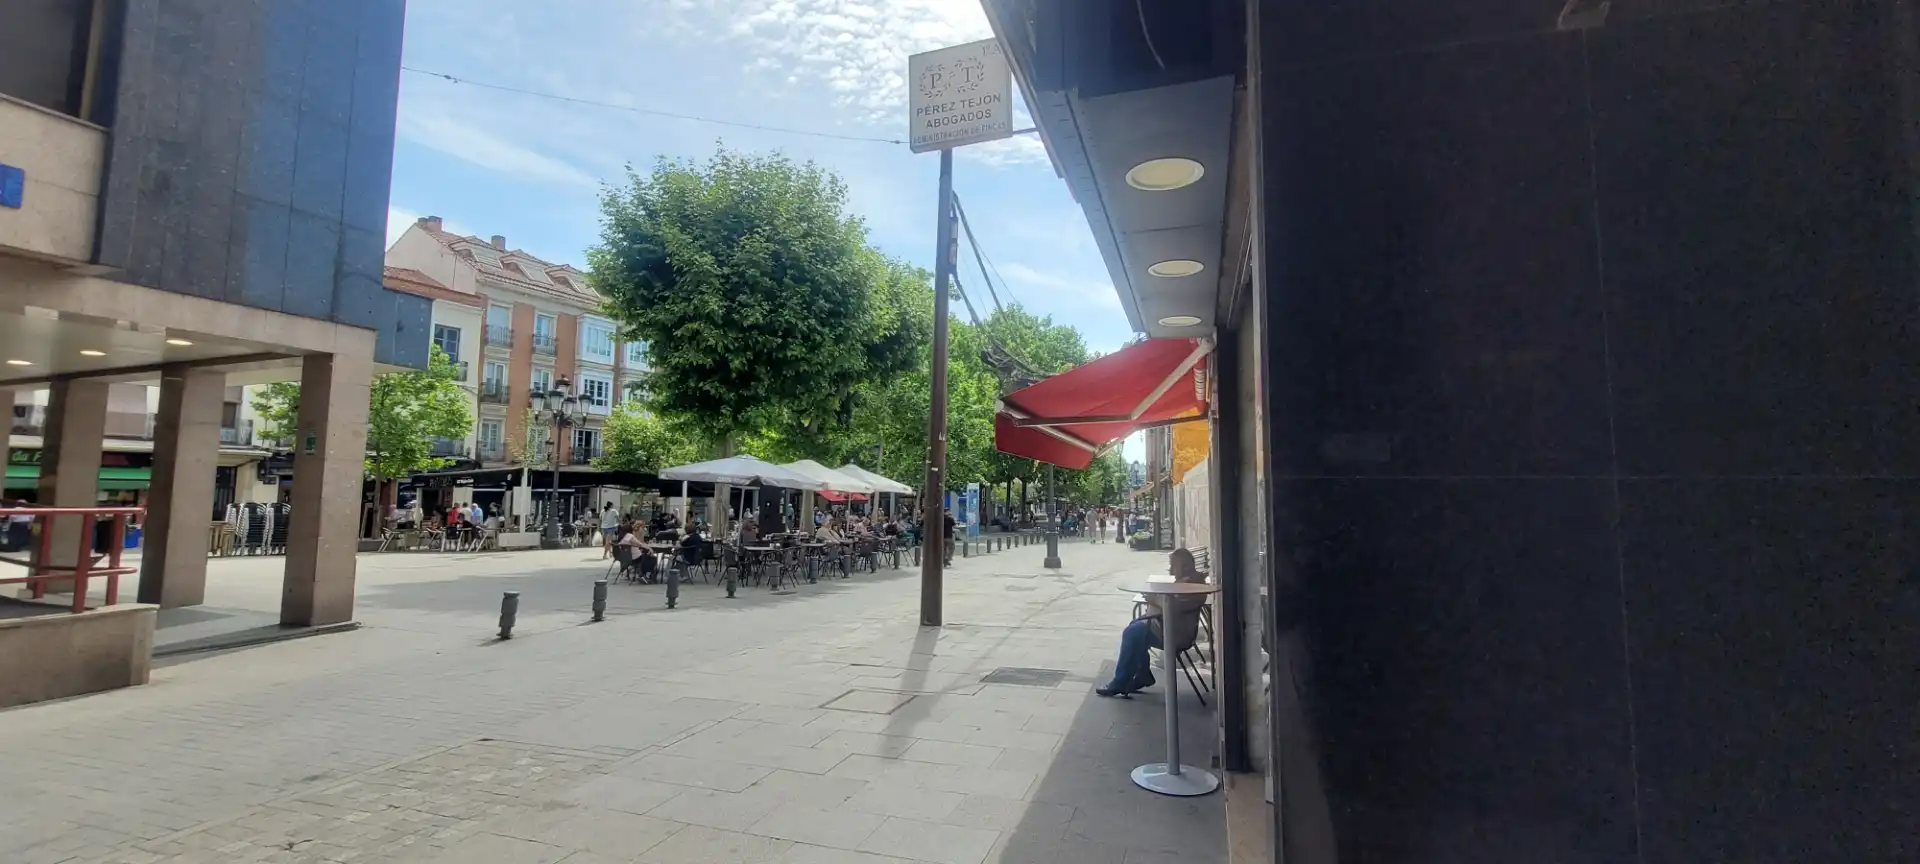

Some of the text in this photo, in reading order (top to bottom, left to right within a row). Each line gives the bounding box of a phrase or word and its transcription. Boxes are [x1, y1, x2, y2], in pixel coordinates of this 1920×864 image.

[930, 66, 974, 90] P T
[916, 92, 1001, 117] PÉREZ TEJÓN
[925, 109, 992, 129] ABOGADOS
